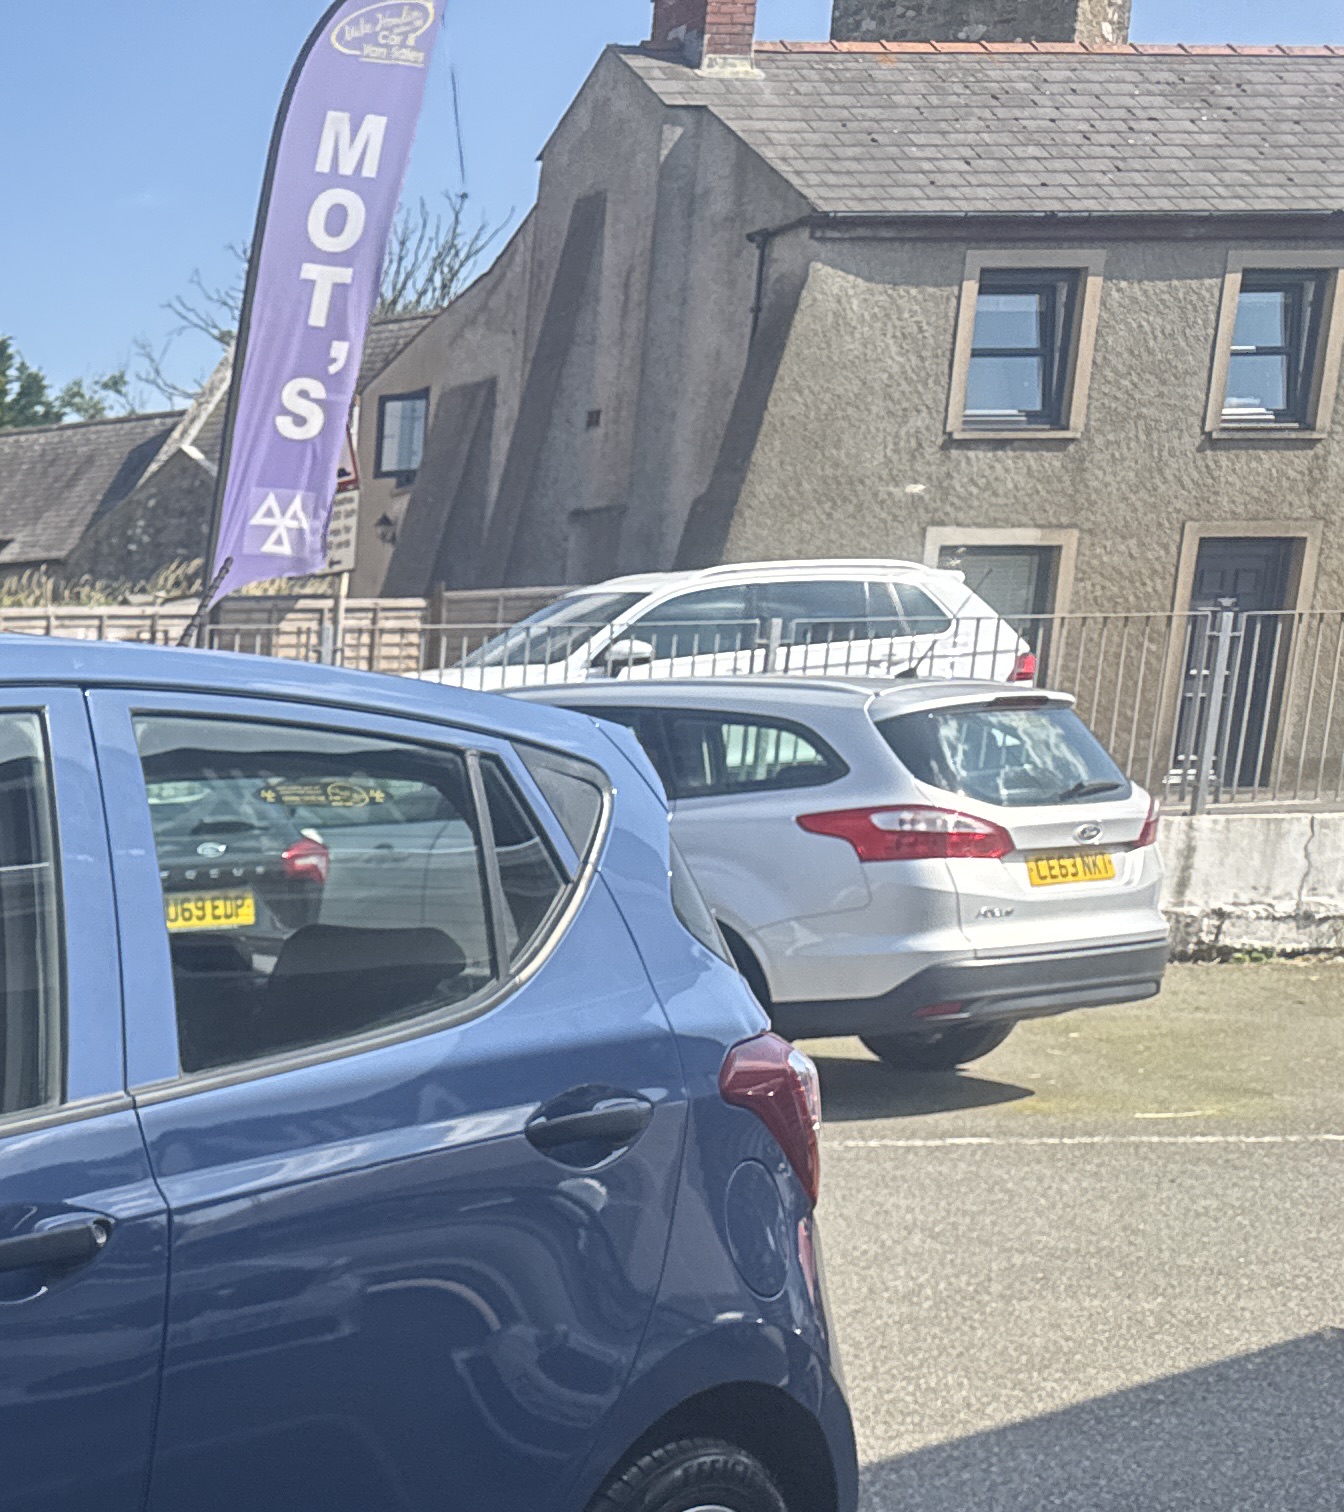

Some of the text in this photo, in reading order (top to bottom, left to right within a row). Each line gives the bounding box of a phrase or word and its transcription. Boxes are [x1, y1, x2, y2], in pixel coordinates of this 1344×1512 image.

[363, 43, 387, 58] Van
[378, 31, 403, 45] Car
[274, 110, 388, 441] MOT'S
[1035, 855, 1079, 880] CE63
[211, 895, 245, 920] EDP
